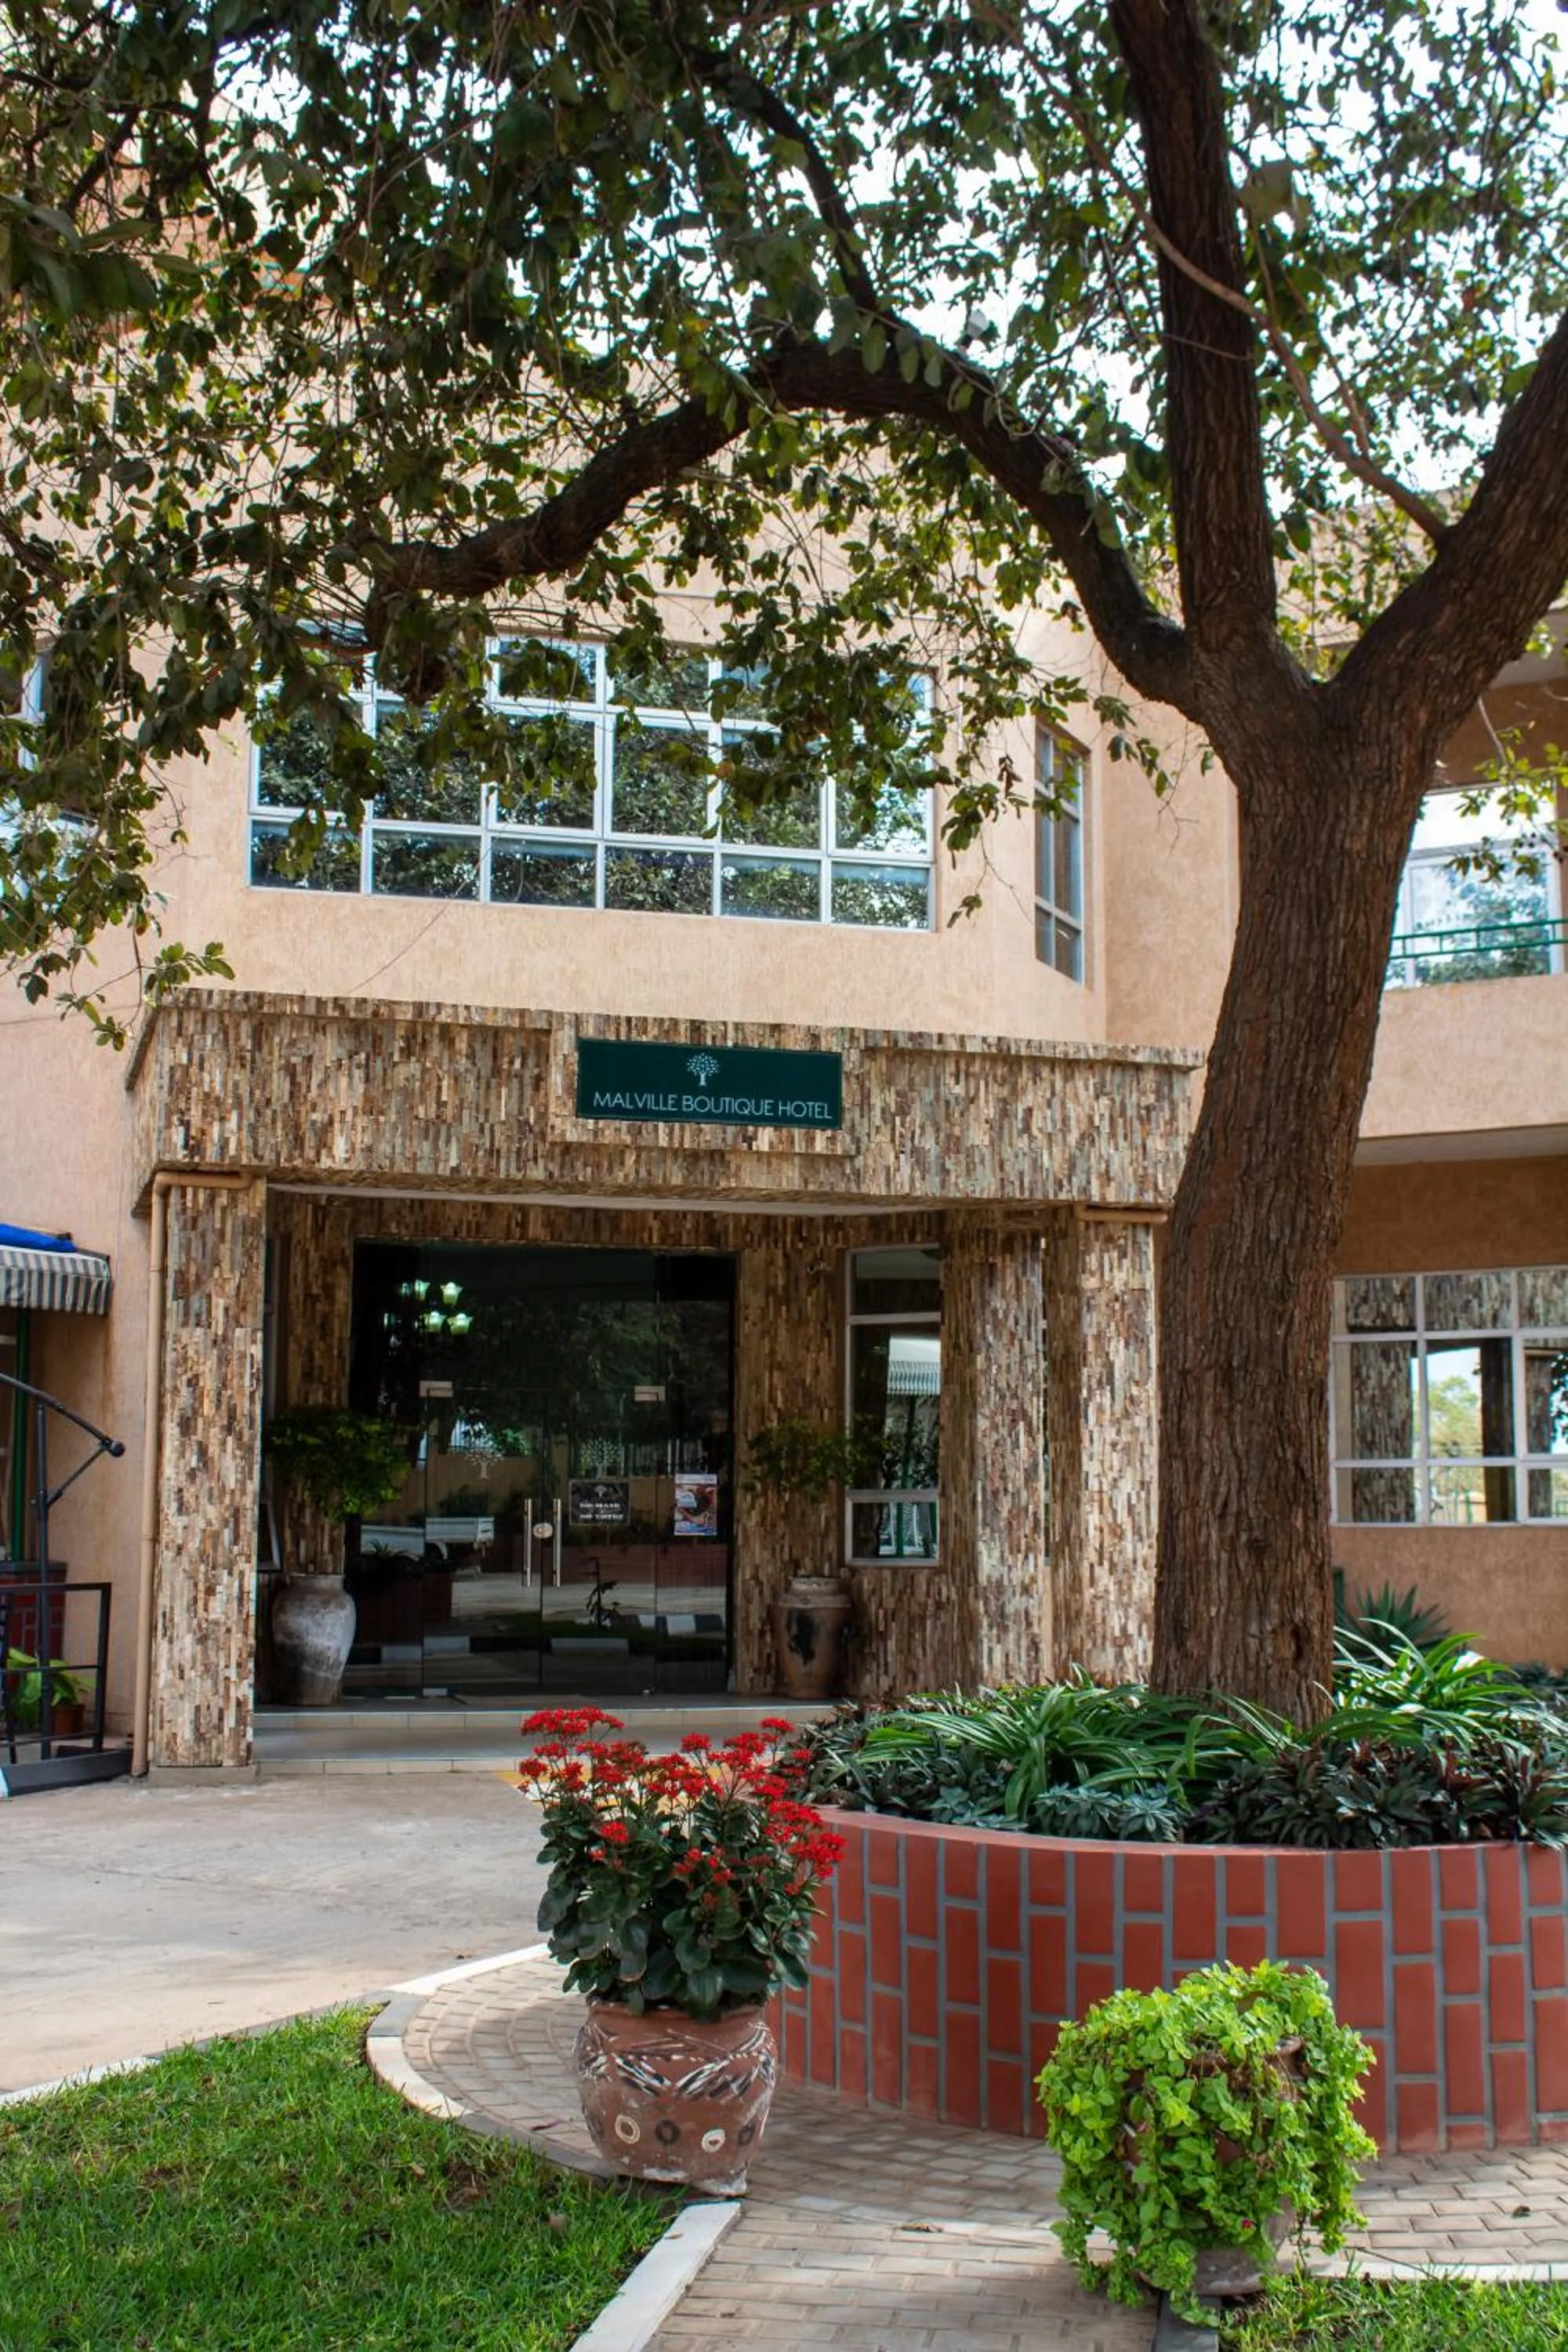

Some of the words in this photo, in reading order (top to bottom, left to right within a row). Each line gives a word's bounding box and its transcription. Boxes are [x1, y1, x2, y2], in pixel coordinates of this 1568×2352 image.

[593, 1091, 677, 1111] MALVILLE
[682, 1095, 774, 1115] BOUTIQUE
[779, 1100, 833, 1119] HOTEL
